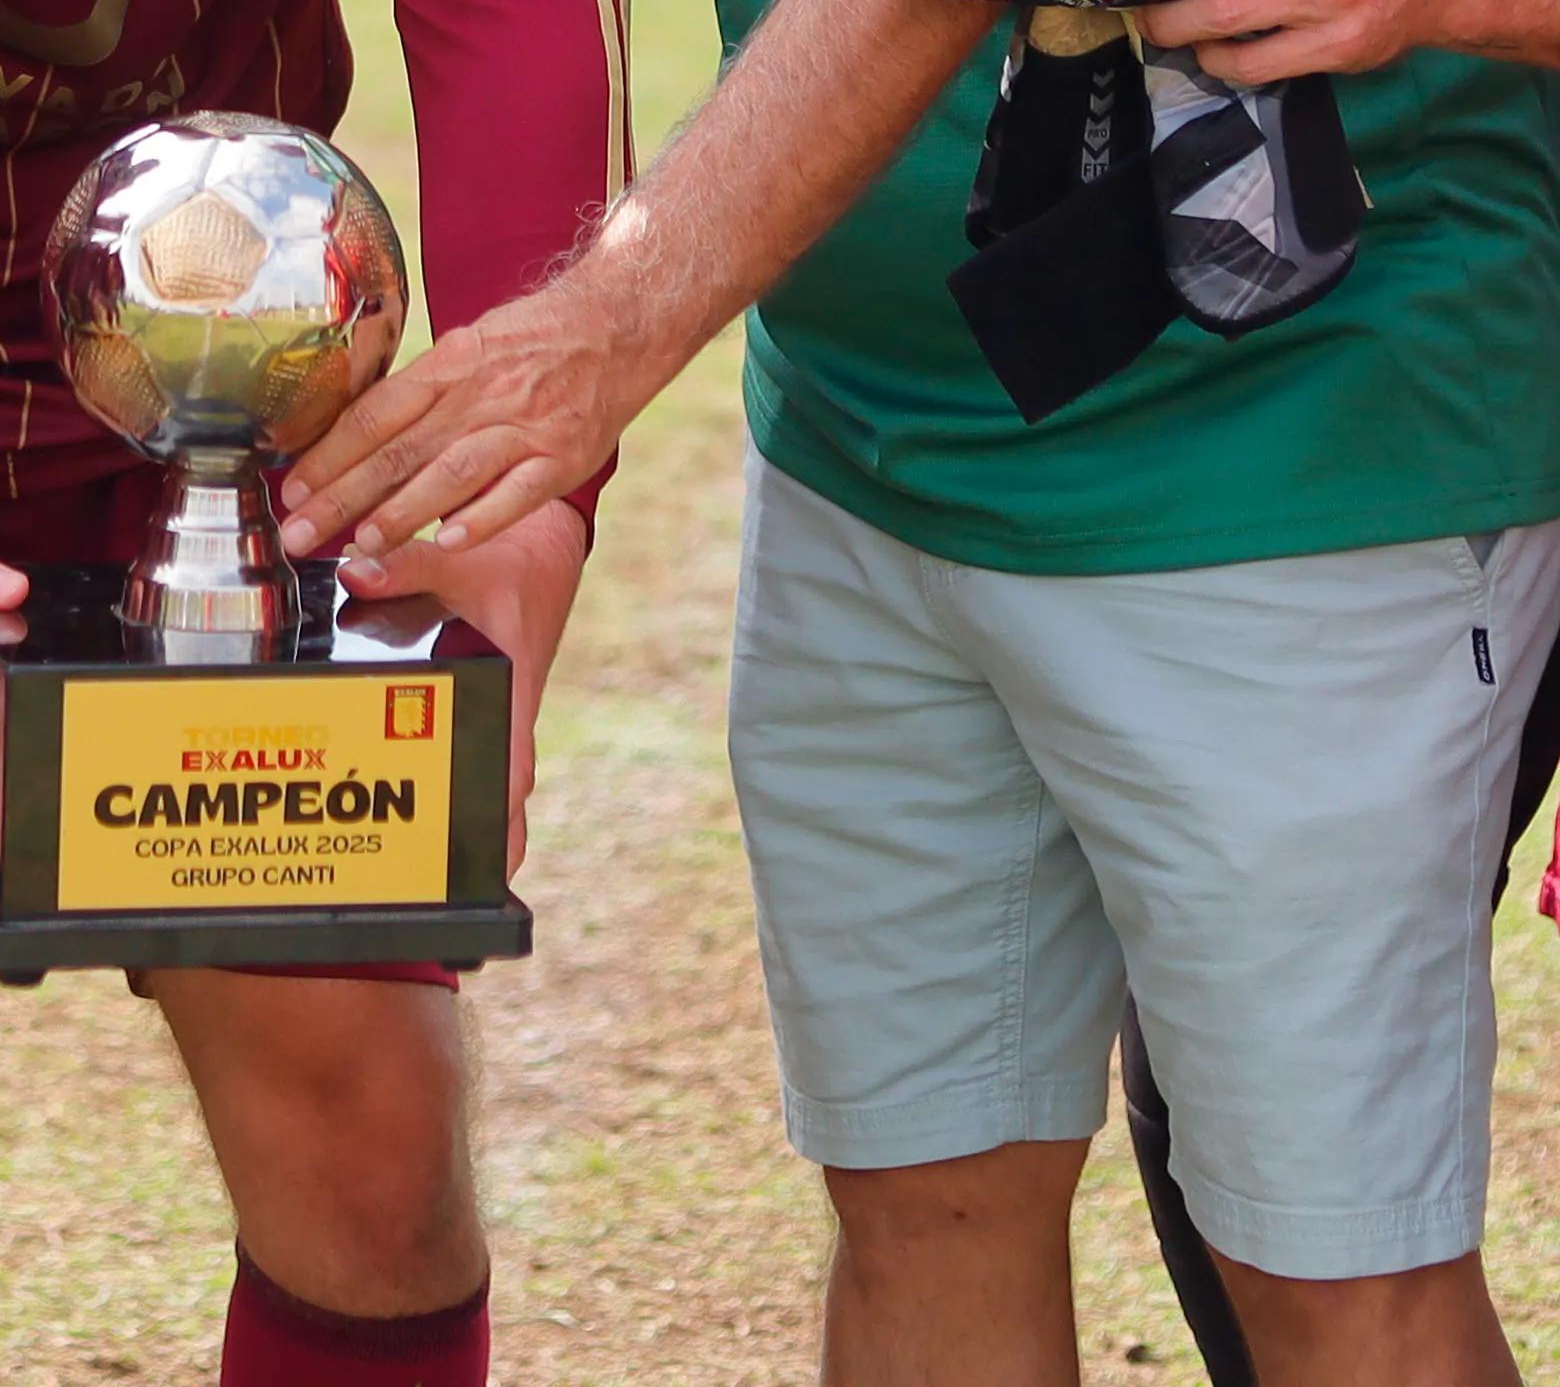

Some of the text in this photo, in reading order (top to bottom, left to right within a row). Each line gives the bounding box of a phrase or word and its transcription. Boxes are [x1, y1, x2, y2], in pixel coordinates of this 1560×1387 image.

[182, 725, 329, 748] TORNEO
[181, 749, 328, 772] EXALUX
[93, 768, 416, 829] CAMPEÓN
[135, 834, 384, 858] COPA EXALUX 2025
[171, 864, 336, 888] GRUPO CANTI
